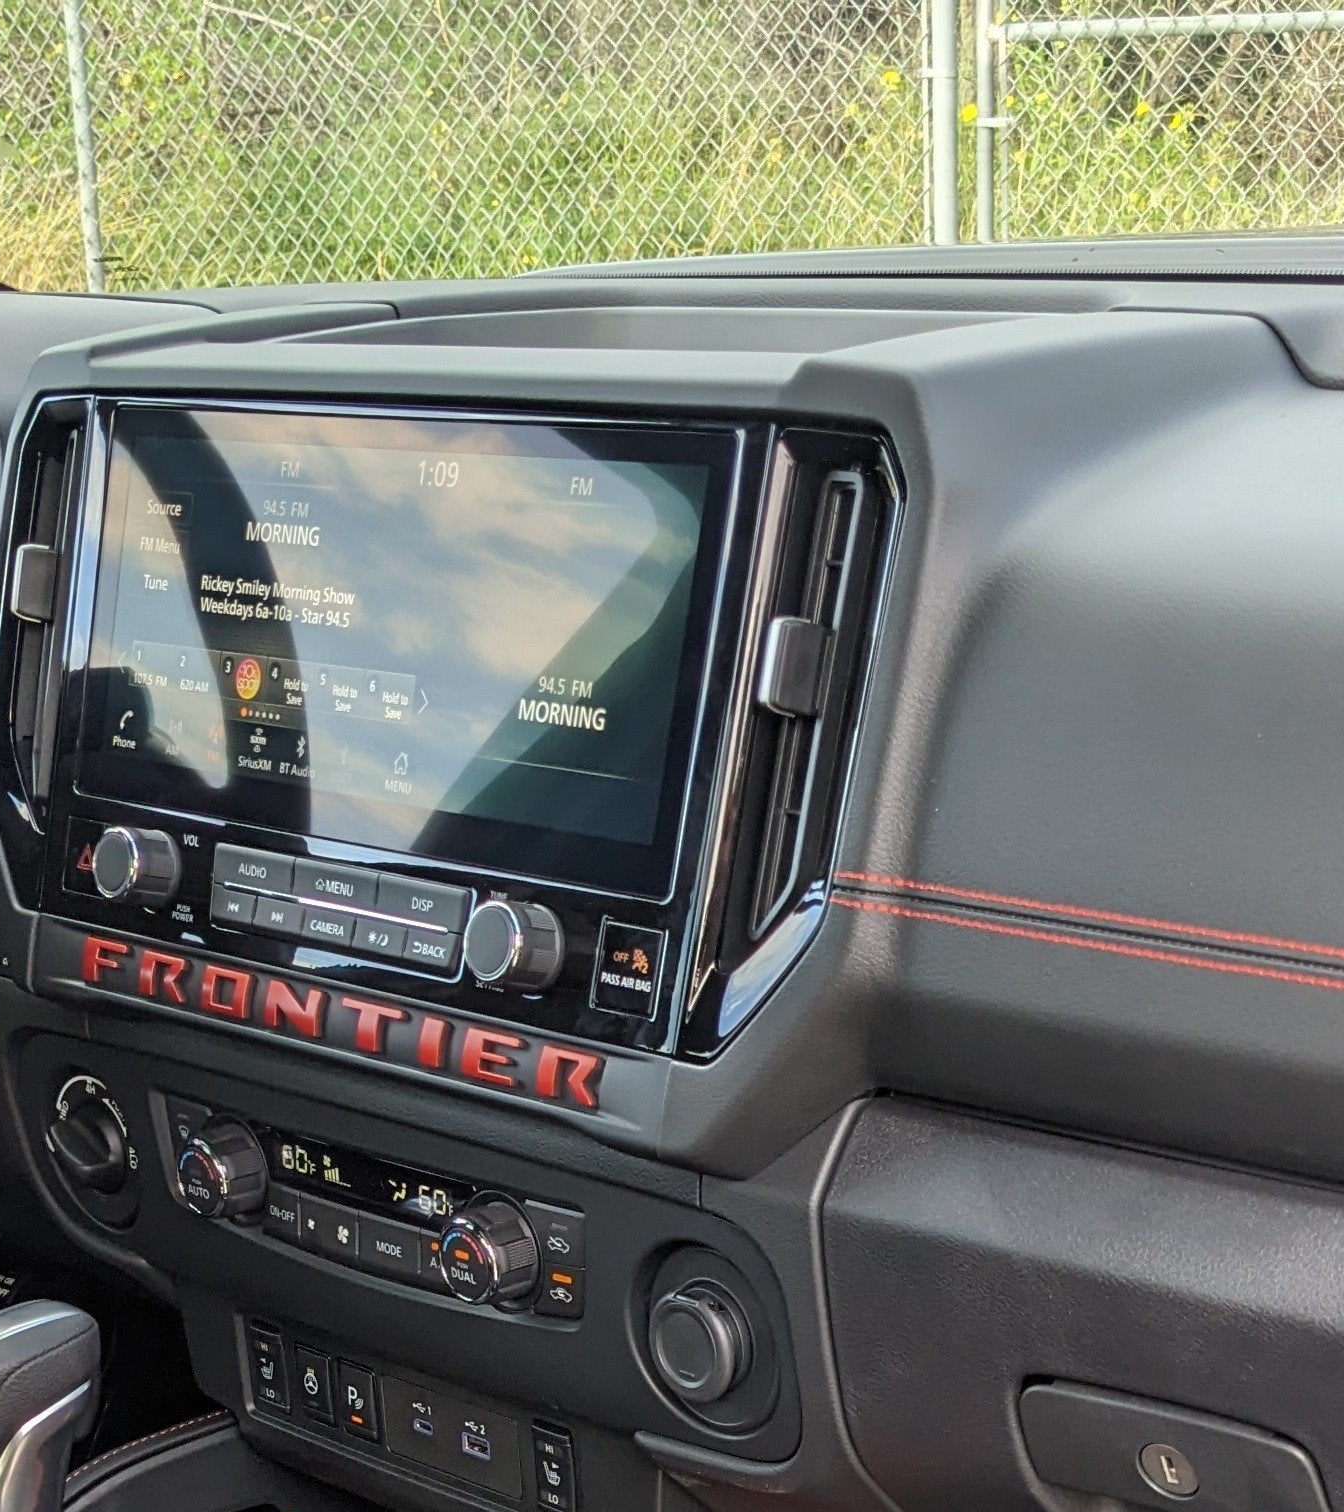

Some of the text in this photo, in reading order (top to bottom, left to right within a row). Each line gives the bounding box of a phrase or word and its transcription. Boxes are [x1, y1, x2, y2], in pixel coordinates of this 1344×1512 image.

[280, 461, 300, 479] FM
[417, 460, 460, 488] 1:09
[569, 476, 594, 497] FM
[146, 499, 182, 517] Source
[263, 500, 309, 518] 94.5 FM
[245, 521, 320, 547] MORNING
[140, 536, 181, 554] FM Menu
[143, 574, 169, 591] Tune
[201, 574, 355, 606] Rickey Smiley Morning Show
[200, 597, 350, 628] Weekdays 6a-10a Star 94.5
[137, 650, 142, 661] 1
[180, 656, 186, 667] 2
[225, 661, 231, 674] 3
[271, 667, 278, 680] 4
[283, 678, 308, 692] Hold to
[320, 674, 326, 686] 5
[369, 680, 376, 693] 6
[538, 676, 593, 699] 94.5 FM
[286, 692, 303, 706] Save
[332, 684, 358, 699] Hold to
[382, 692, 409, 706] Hold to
[334, 699, 351, 713] Save
[384, 707, 402, 720] Save
[518, 698, 606, 731] MORNING
[112, 735, 137, 750] Phone
[238, 755, 272, 772] SiriusXM
[279, 761, 291, 775] BT
[290, 763, 316, 779] Audio
[384, 779, 412, 793] MENU
[183, 833, 200, 848] VOL
[238, 863, 267, 879] AUDIO
[324, 879, 354, 897] MENU
[411, 897, 434, 912] DISP
[310, 919, 344, 937] CAMERA
[421, 943, 446, 959] BACK
[612, 951, 629, 963] OFF
[600, 971, 652, 993] PASS AIR BAG
[80, 934, 604, 1109] FRONTIER
[187, 1185, 210, 1200] AUTO
[376, 1240, 403, 1258] MODE
[451, 1266, 477, 1285] DUAL
[266, 1387, 275, 1399] LO
[548, 1493, 559, 1505] LO
